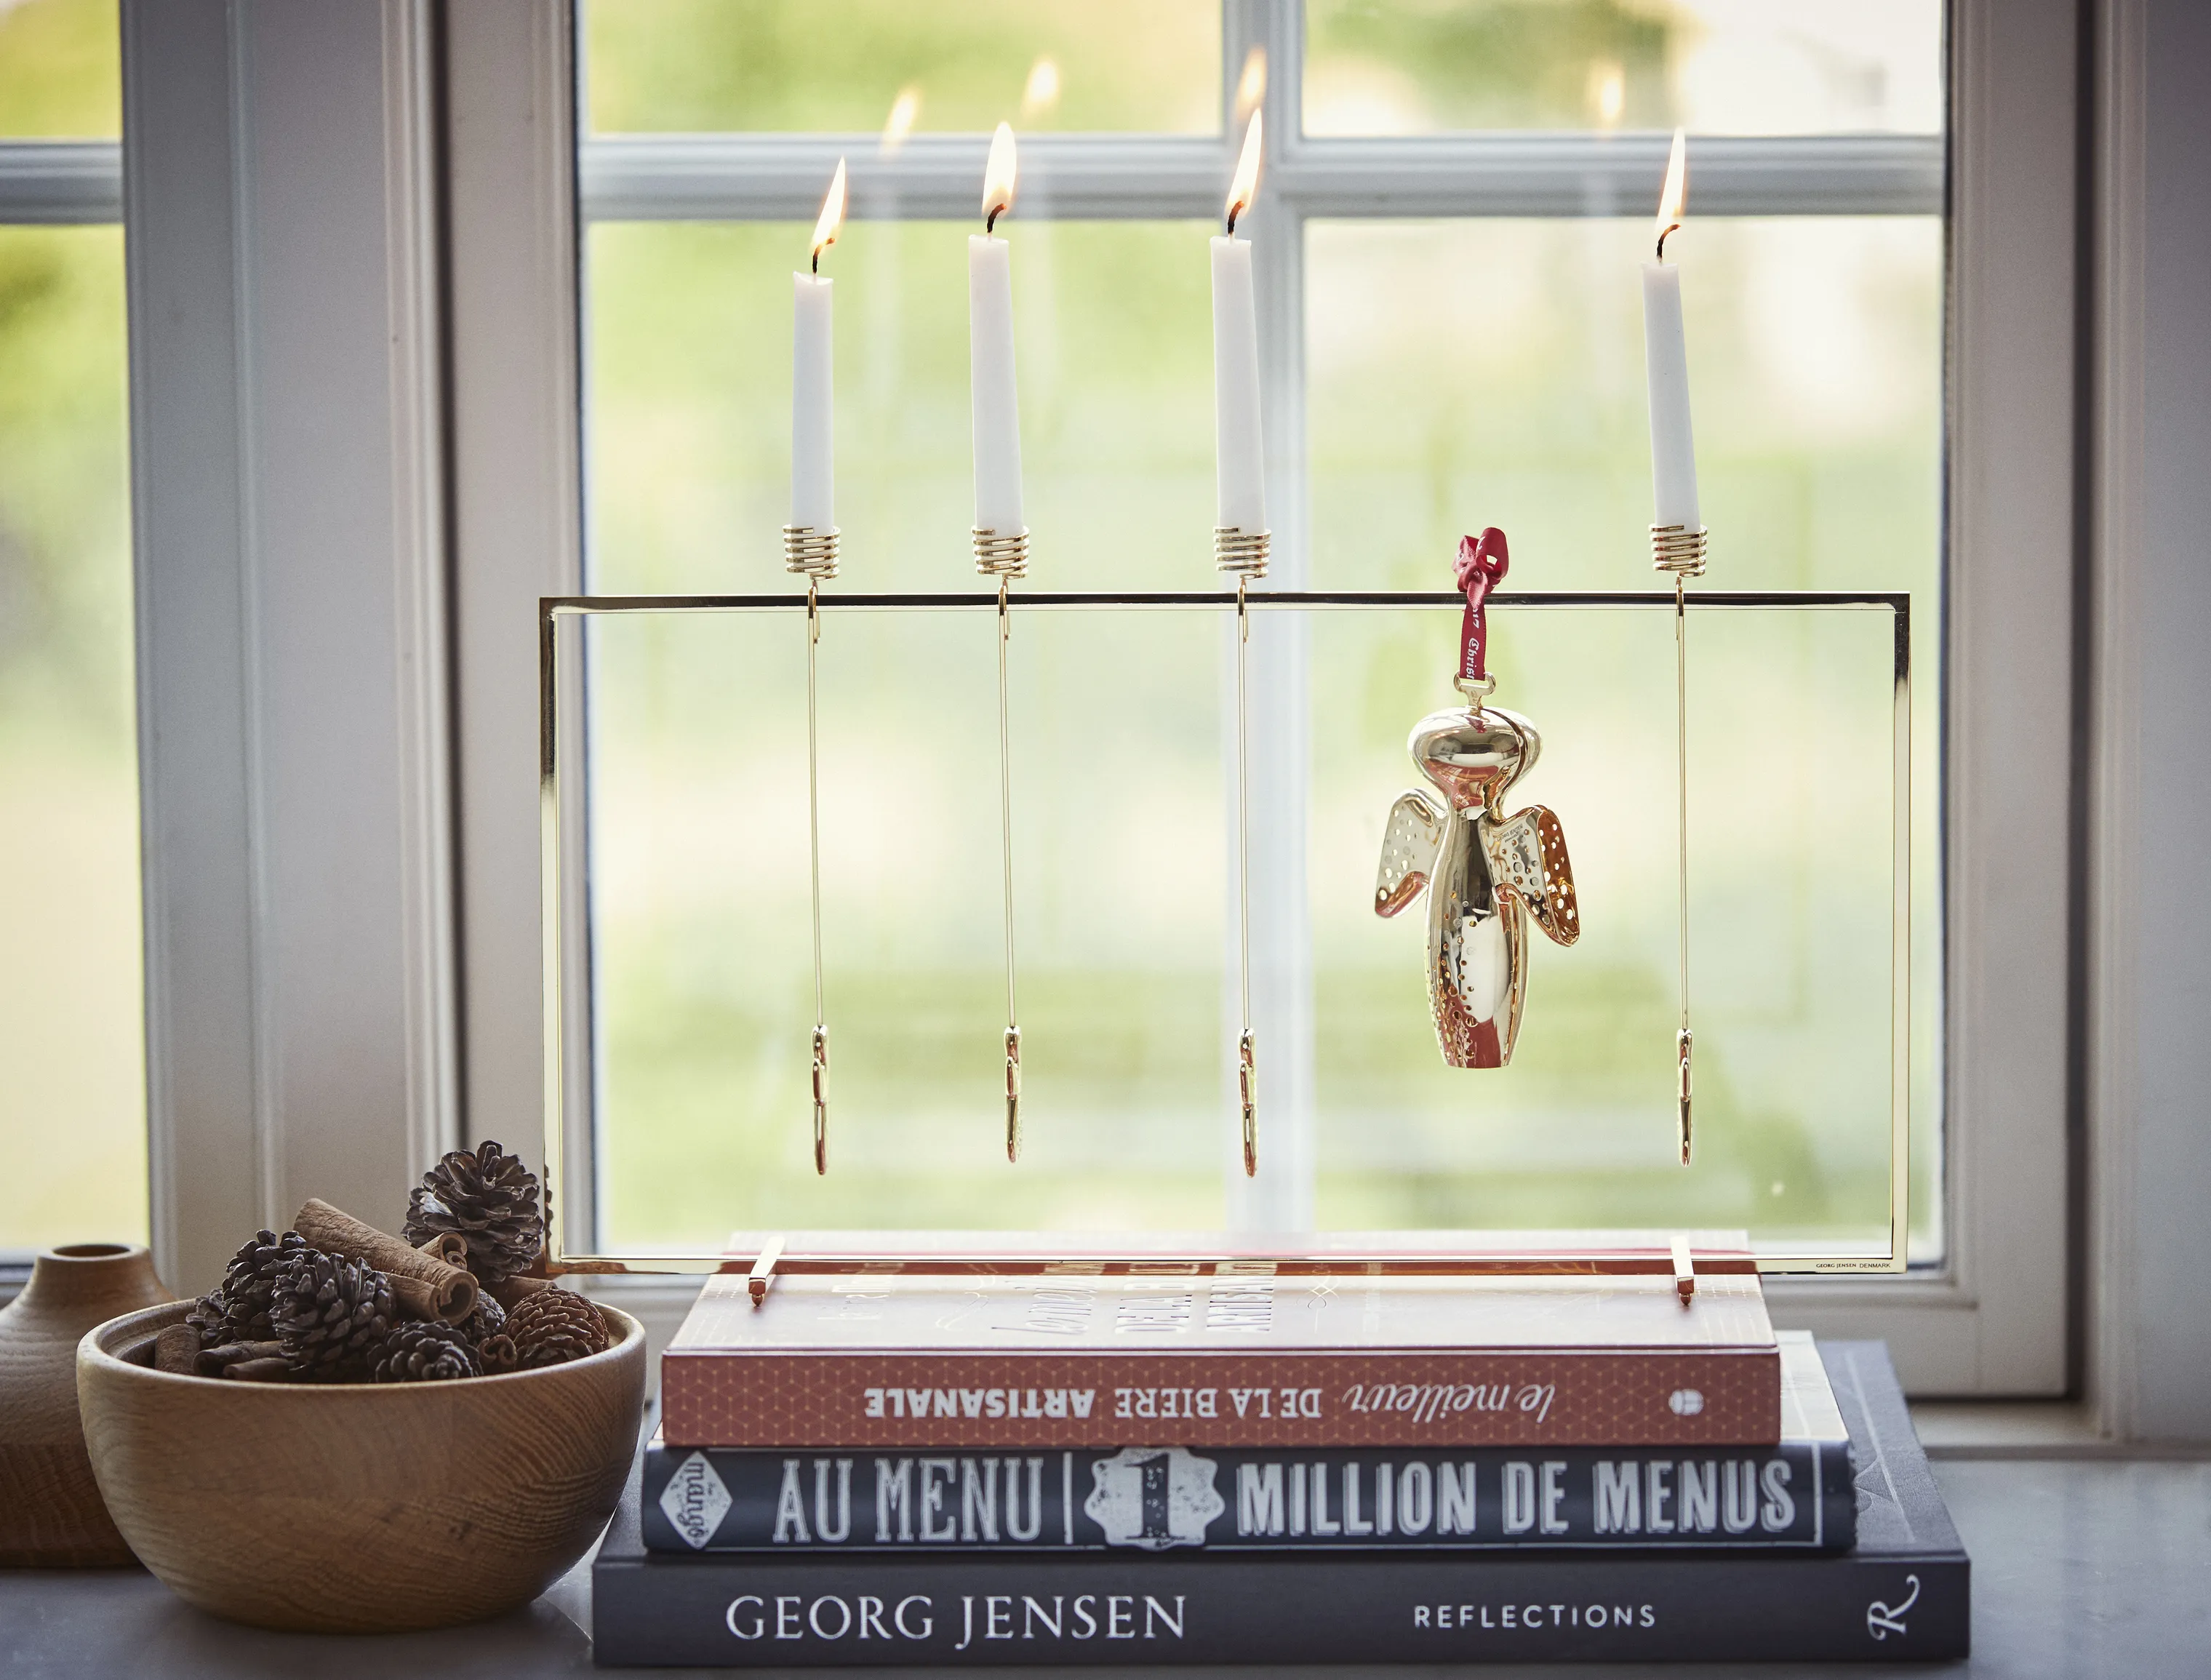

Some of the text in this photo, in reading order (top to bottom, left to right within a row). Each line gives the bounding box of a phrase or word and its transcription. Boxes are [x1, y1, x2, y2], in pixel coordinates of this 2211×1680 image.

[863, 1383, 1556, 1423] le meilleur DE LA BIERE ARTISANALE
[676, 1461, 705, 1538] mango
[772, 1457, 1044, 1543] AU MENU
[1124, 1452, 1796, 1540] 1 MILLION DE MENUS
[727, 1595, 1188, 1650] GEORG JENSEN
[1414, 1604, 1657, 1628] REFLECTIONS
[1866, 1574, 1921, 1641] R
